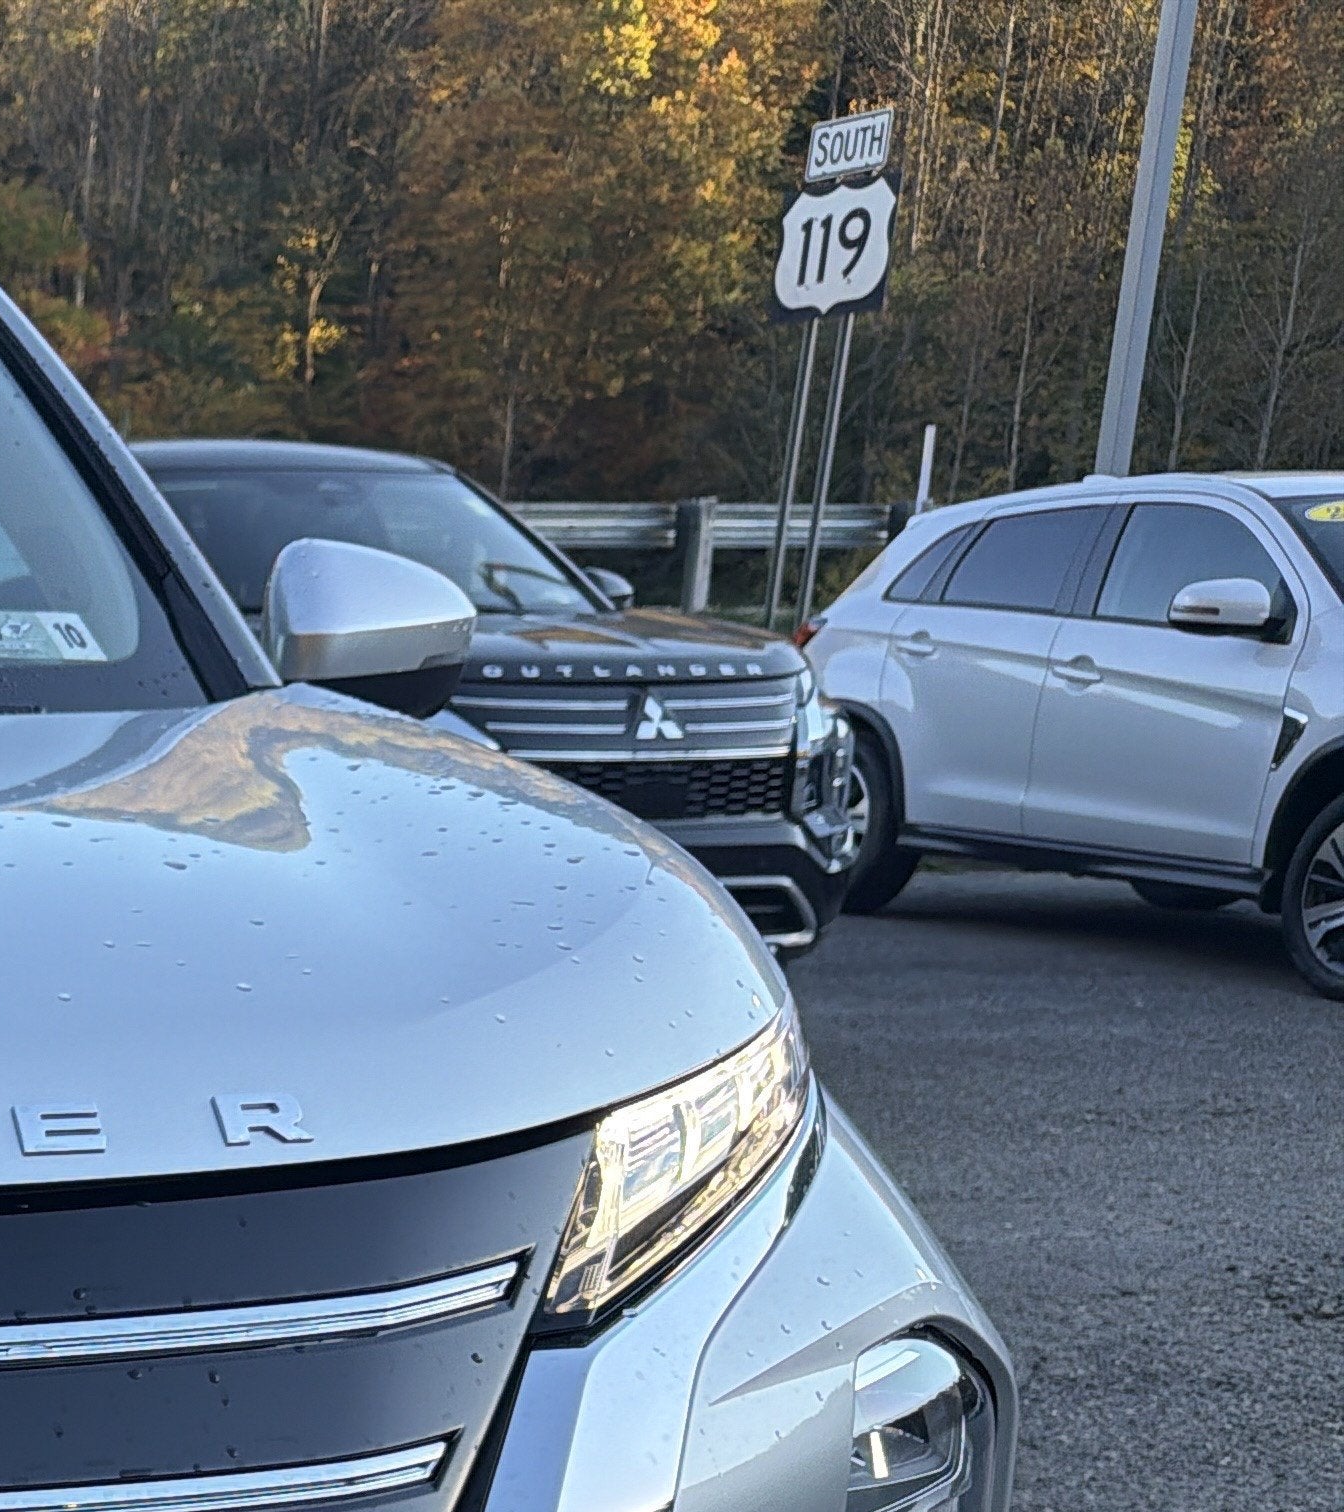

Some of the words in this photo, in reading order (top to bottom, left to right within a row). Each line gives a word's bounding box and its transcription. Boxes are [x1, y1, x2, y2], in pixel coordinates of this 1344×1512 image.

[815, 123, 884, 167] SOUTH
[797, 208, 871, 287] 119
[52, 622, 88, 649] 10
